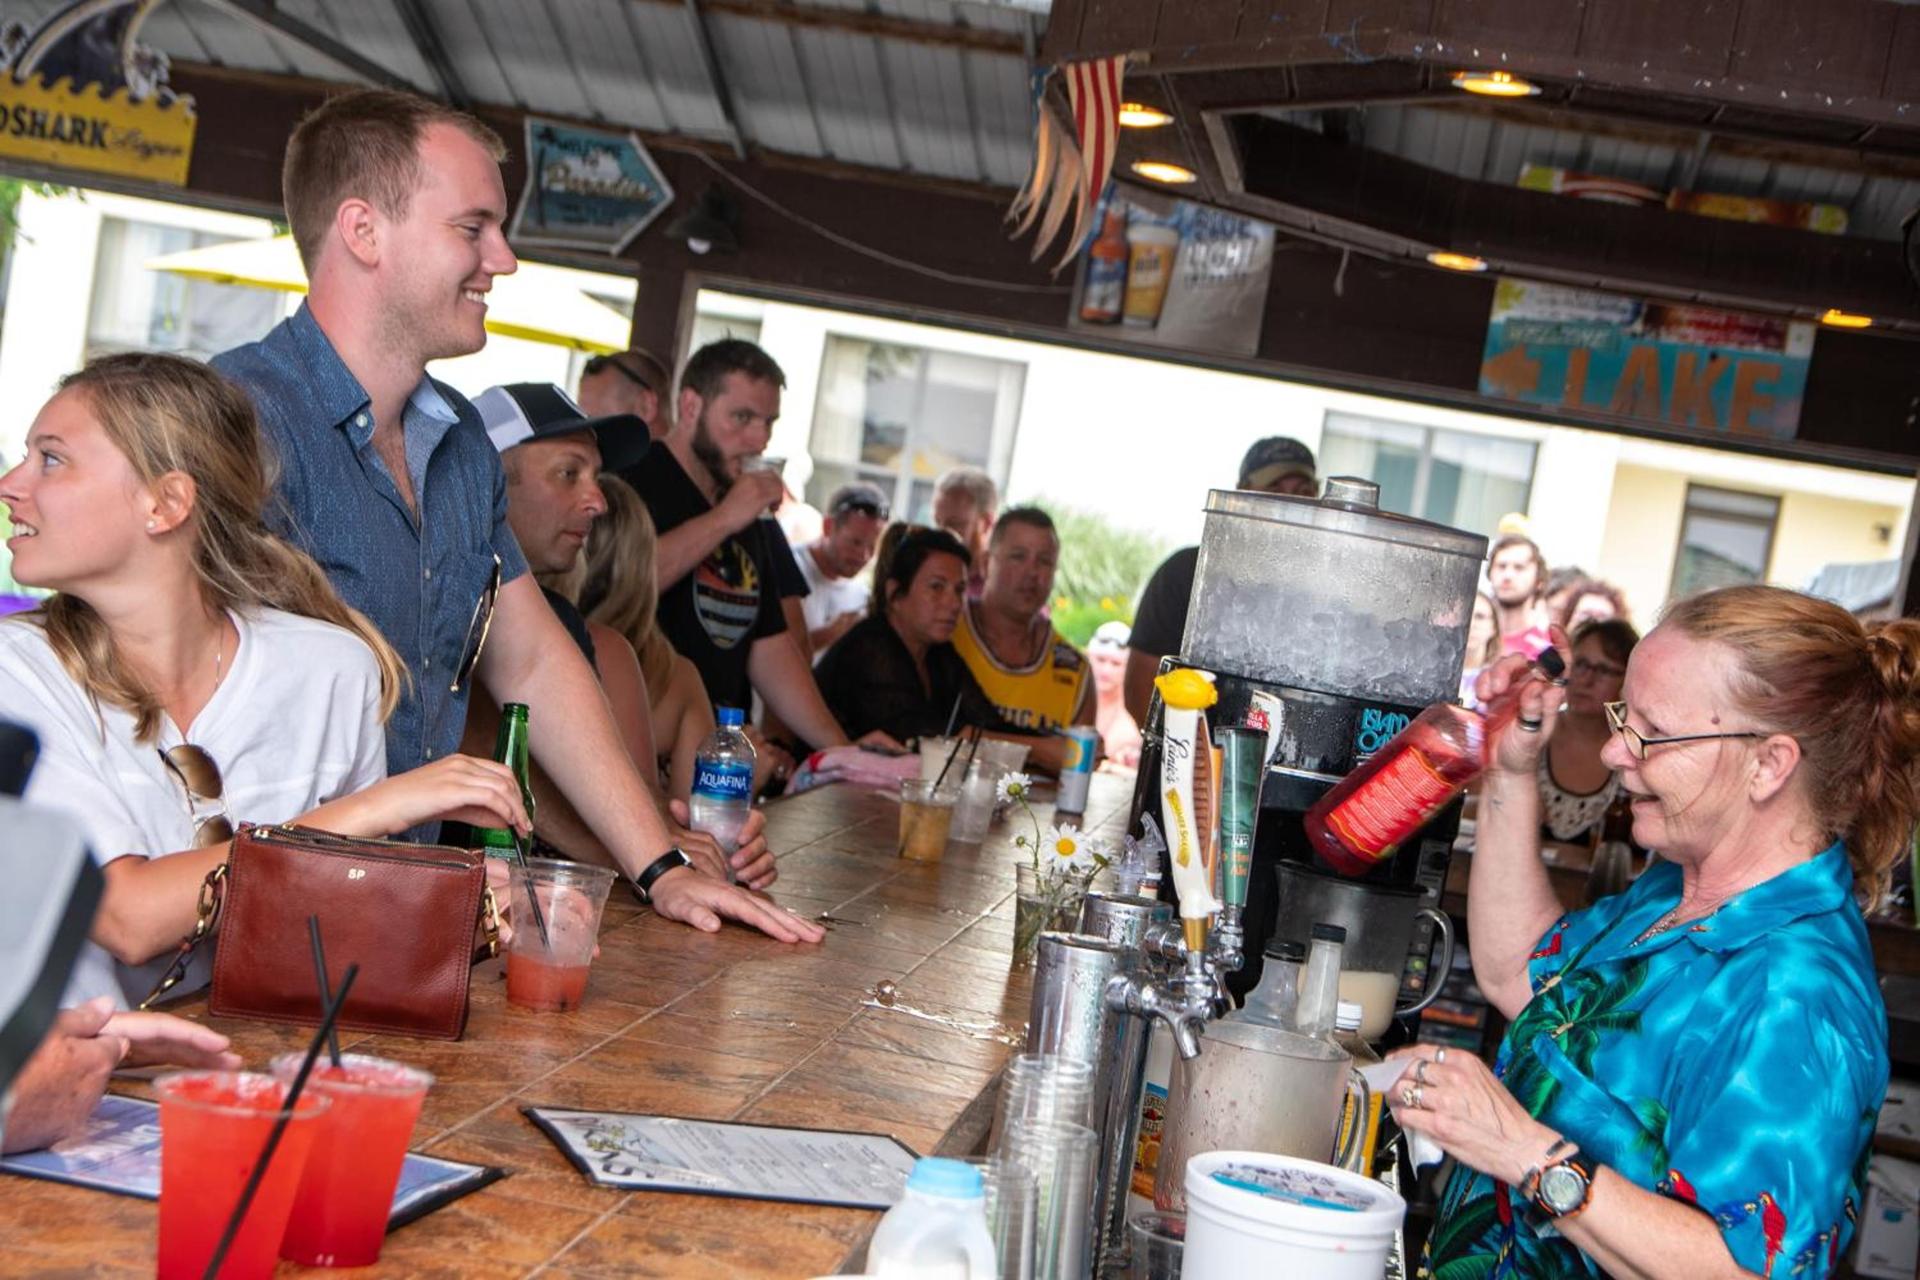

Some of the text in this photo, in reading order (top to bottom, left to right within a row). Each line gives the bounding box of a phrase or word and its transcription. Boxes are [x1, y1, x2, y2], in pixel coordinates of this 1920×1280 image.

[1561, 343, 1782, 439] LAKE
[698, 771, 748, 791] AQUAFINA
[348, 868, 366, 880] SP
